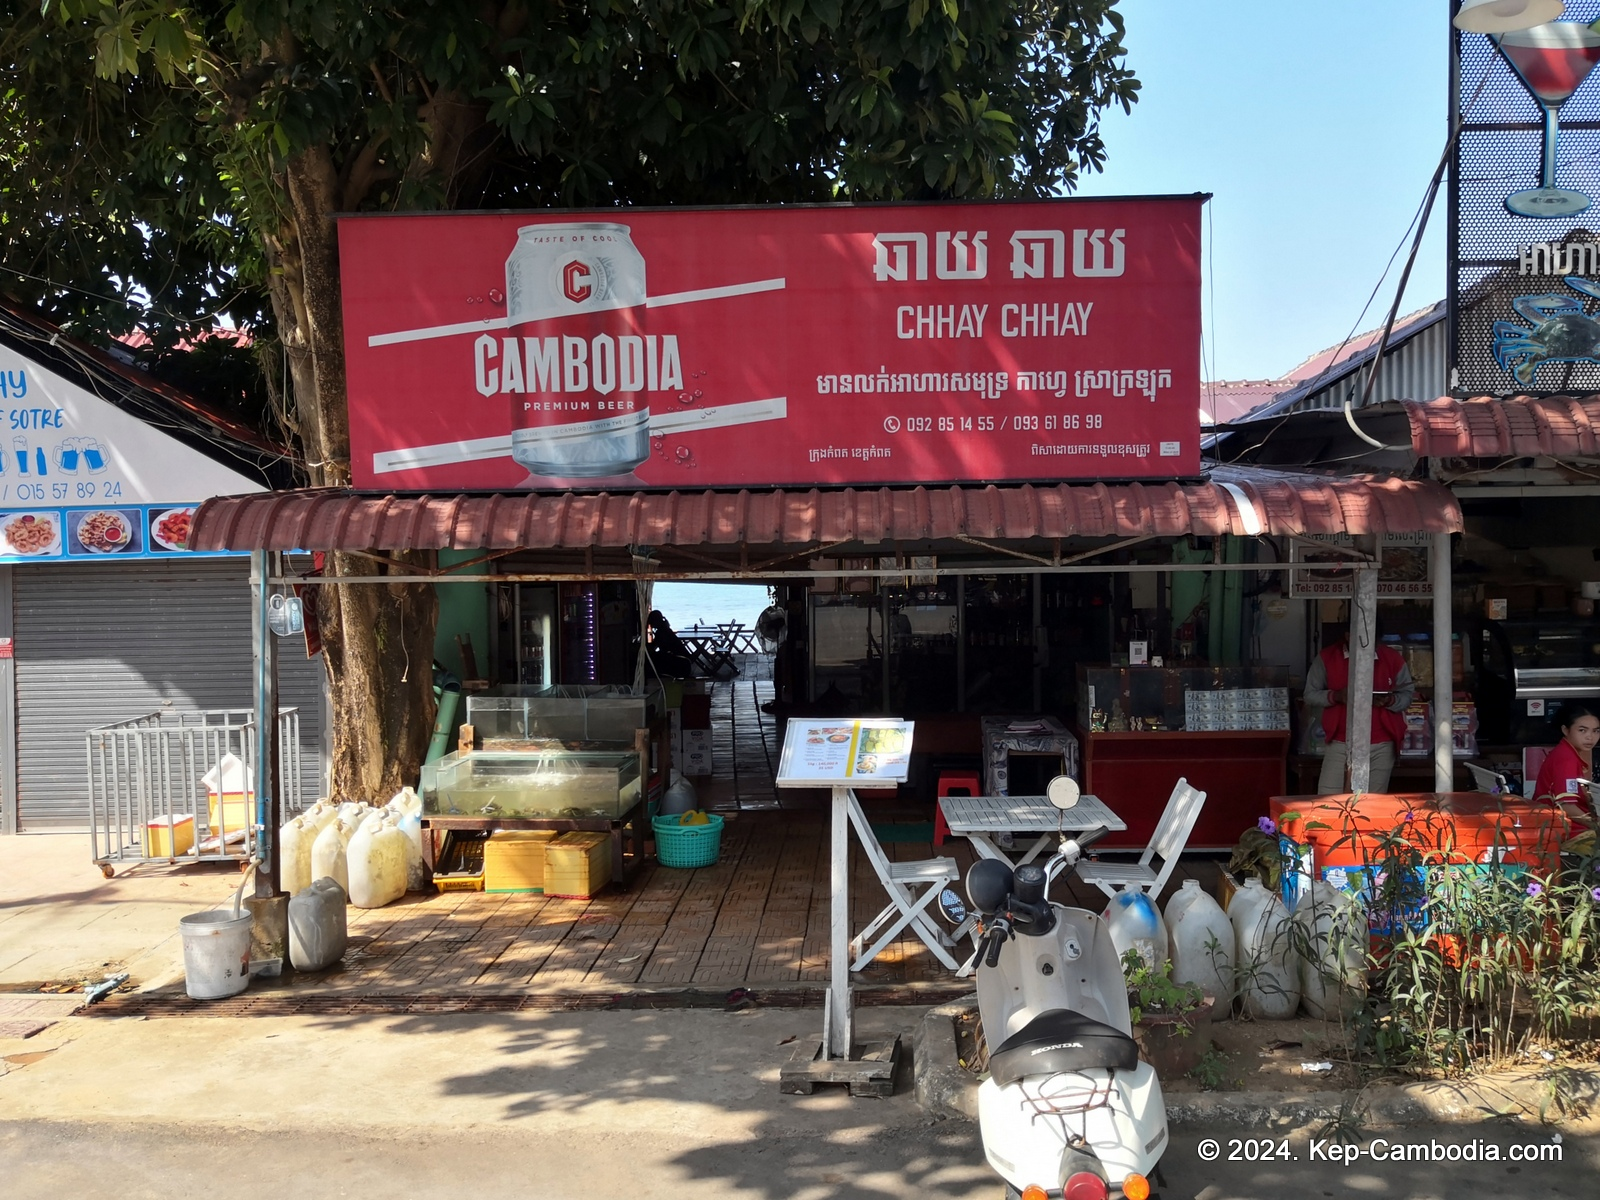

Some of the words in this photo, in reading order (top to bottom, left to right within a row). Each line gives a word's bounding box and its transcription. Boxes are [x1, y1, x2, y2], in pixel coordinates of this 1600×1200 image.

[896, 304, 989, 340] CHHAY
[1001, 302, 1094, 338] CHHAY
[474, 332, 684, 398] CAMBODIA
[524, 402, 590, 411] PREMIUM
[598, 401, 635, 410] BEER
[9, 409, 64, 430] SOTRE
[907, 417, 932, 432] 092
[938, 417, 954, 432] 85
[959, 417, 973, 431] 14
[977, 416, 995, 431] 55
[1000, 416, 1008, 430] /
[1013, 415, 1039, 430] 093
[1044, 415, 1057, 429] 61
[1063, 415, 1080, 430] 86
[1085, 414, 1103, 429] 98
[560, 425, 593, 434] CAMBODIA
[16, 484, 45, 500] 015
[52, 483, 68, 499] 57
[76, 482, 96, 498] 89
[103, 481, 122, 497] 24
[1295, 584, 1311, 592] Tel:
[1313, 584, 1330, 592] 092
[1332, 584, 1343, 592] 85
[1376, 583, 1393, 592] 070
[1395, 583, 1406, 592] 46
[1408, 583, 1420, 592] 56
[1421, 583, 1433, 592] 55
[1031, 1042, 1083, 1056] HONDA
